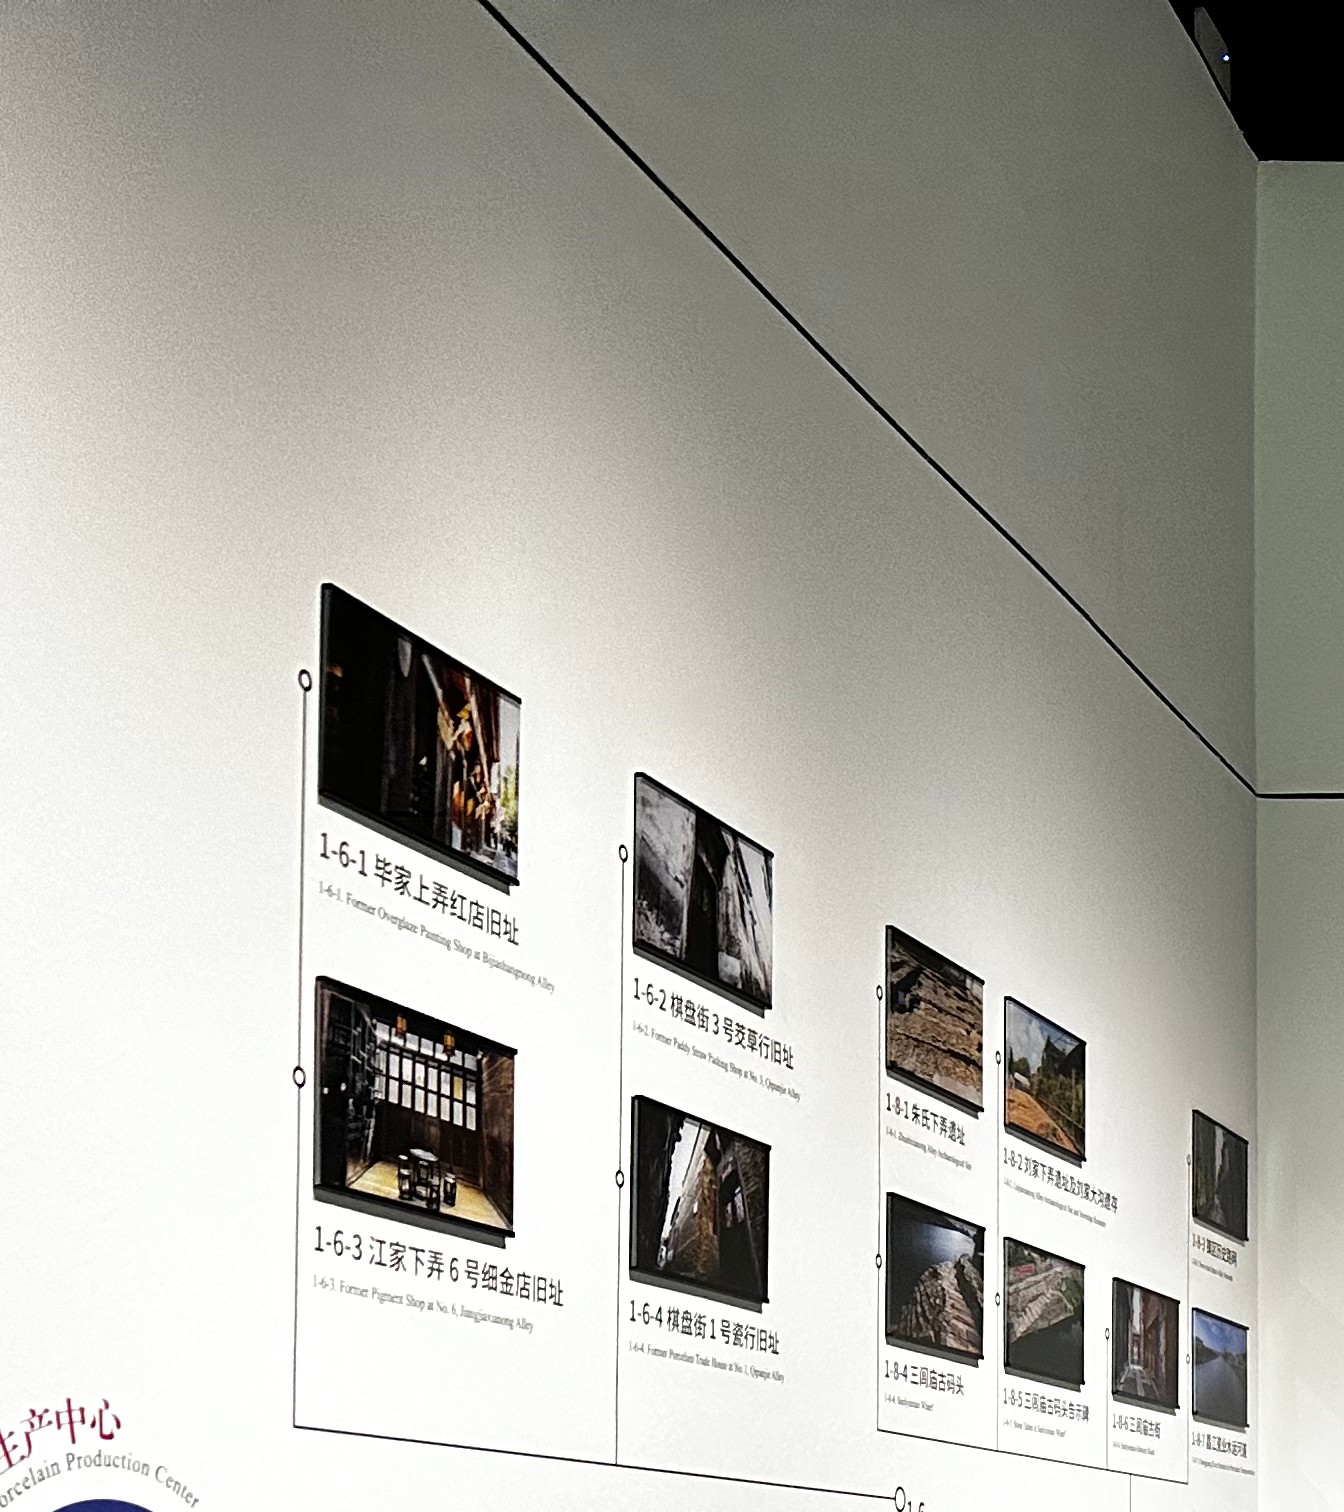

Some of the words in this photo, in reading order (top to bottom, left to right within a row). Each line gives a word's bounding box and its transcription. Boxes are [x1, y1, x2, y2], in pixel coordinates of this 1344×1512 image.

[320, 832, 367, 877] 1-6-1
[374, 854, 519, 946] 毕家上弄红店旧址
[453, 939, 473, 959] Shop
[634, 977, 667, 1012] 1-6-2
[671, 992, 709, 1032] 棋盘街
[886, 1092, 909, 1120] 1-8-1
[1003, 1148, 1022, 1171] 1-8-2
[314, 1226, 363, 1261] 1-6-3
[369, 1236, 444, 1281] 江家下弄
[464, 1259, 564, 1307] 号细金店旧址
[406, 1294, 425, 1312] Shop
[630, 1300, 662, 1328] 1-6-4
[667, 1306, 706, 1339] 棋盘街
[720, 1319, 779, 1355] 号瓷行旧址
[884, 1360, 908, 1383] 1-8-4
[1003, 1388, 1022, 1407] 1-8-5
[66, 1449, 150, 1476] Production
[155, 1466, 199, 1508] Center
